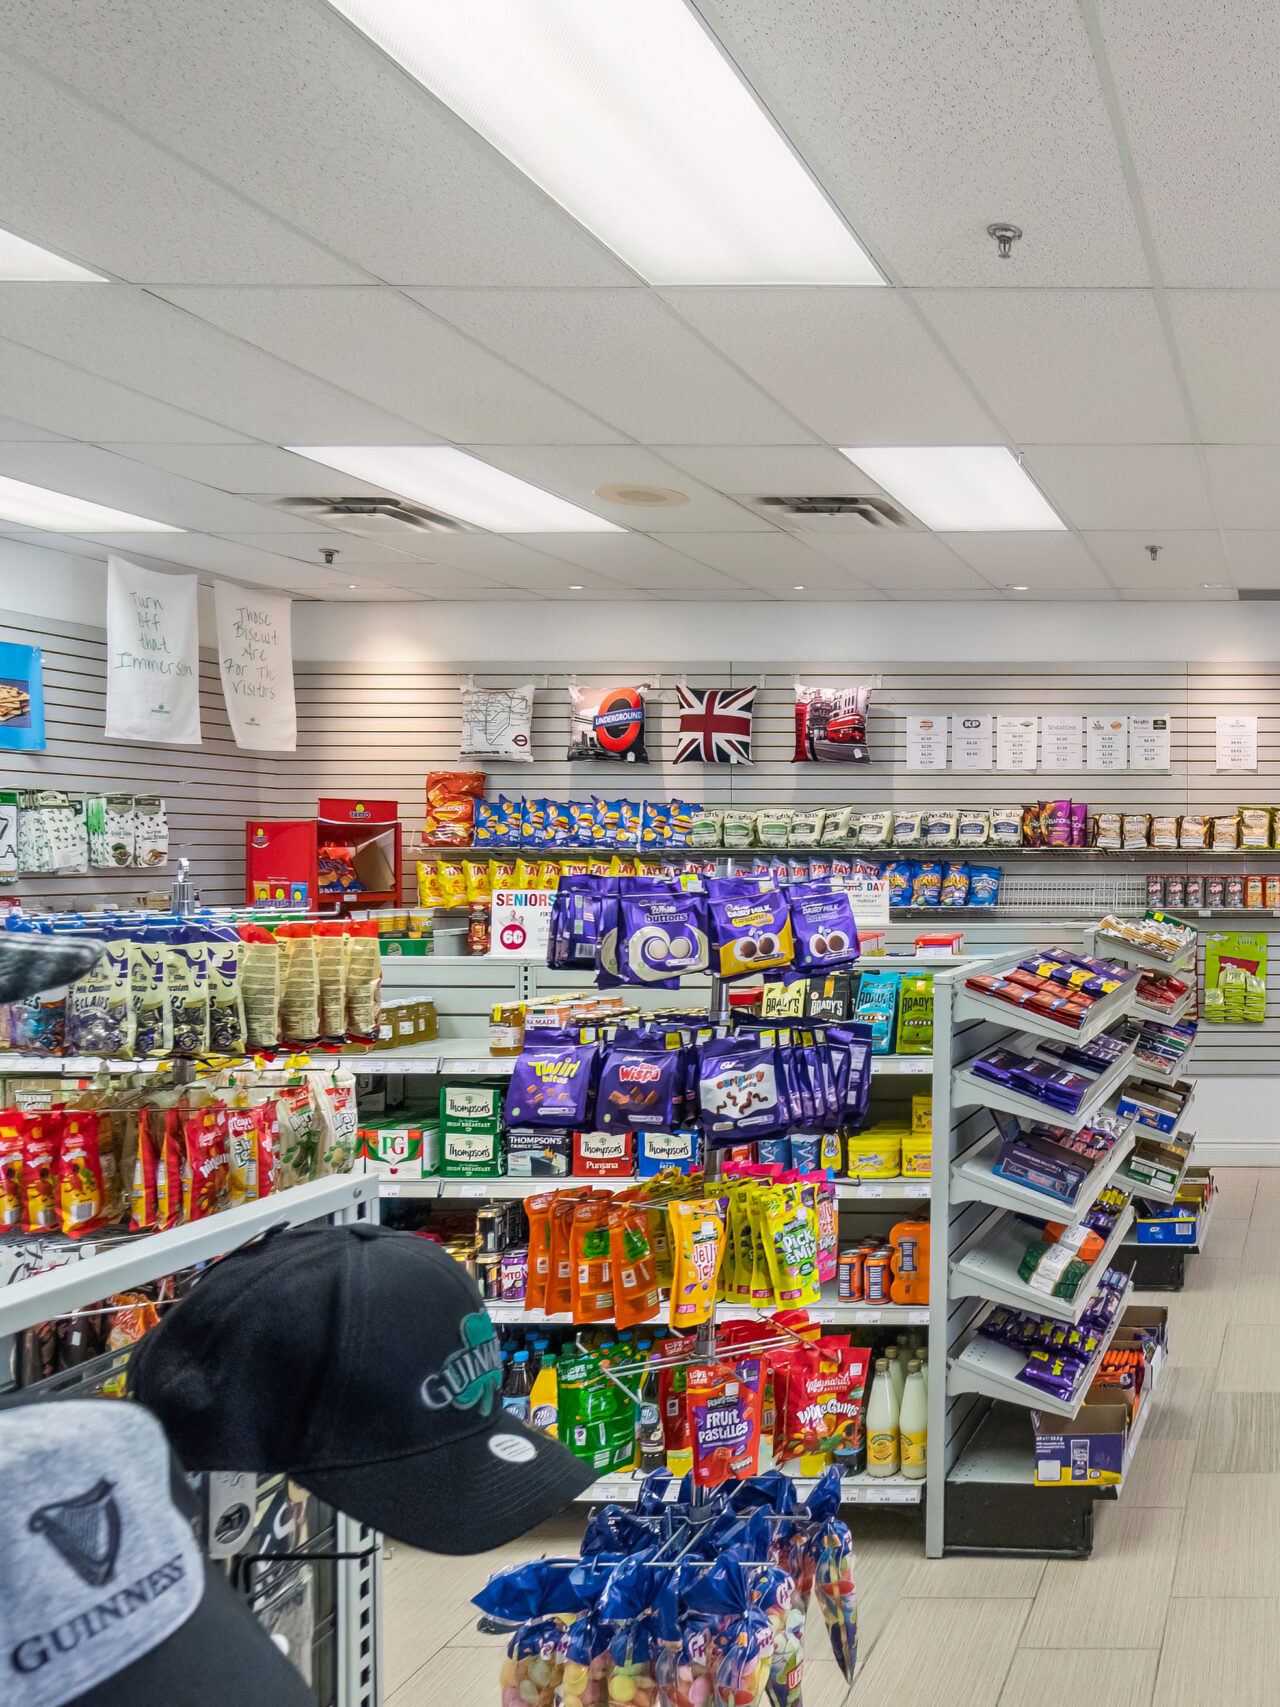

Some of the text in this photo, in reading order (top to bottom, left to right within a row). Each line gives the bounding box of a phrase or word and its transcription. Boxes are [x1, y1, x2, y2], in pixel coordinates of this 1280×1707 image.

[129, 591, 163, 610] Turn
[236, 606, 272, 627] Those
[138, 633, 170, 654] that
[595, 711, 643, 726] UNDERGROUND
[962, 719, 981, 729] KP
[867, 883, 885, 891] DAY
[496, 893, 557, 907] SENIORS
[645, 913, 688, 924] buttons
[727, 904, 772, 918] DAIRY MILK
[810, 999, 843, 1017] BRADY'S
[528, 1057, 581, 1078] Twirl
[619, 1065, 661, 1083] Wispa
[449, 1098, 491, 1116] Thompson's
[382, 1135, 405, 1156] PG
[509, 1136, 563, 1145] THOMPSON'S
[583, 1142, 624, 1157] Thompson's
[647, 1141, 689, 1157] Thompson's
[448, 1142, 491, 1160] Thompson's
[585, 1161, 619, 1171] Punjana
[782, 1230, 815, 1253] Pick
[806, 1372, 851, 1394] Maynards
[9, 1552, 188, 1676] GUINNESS
